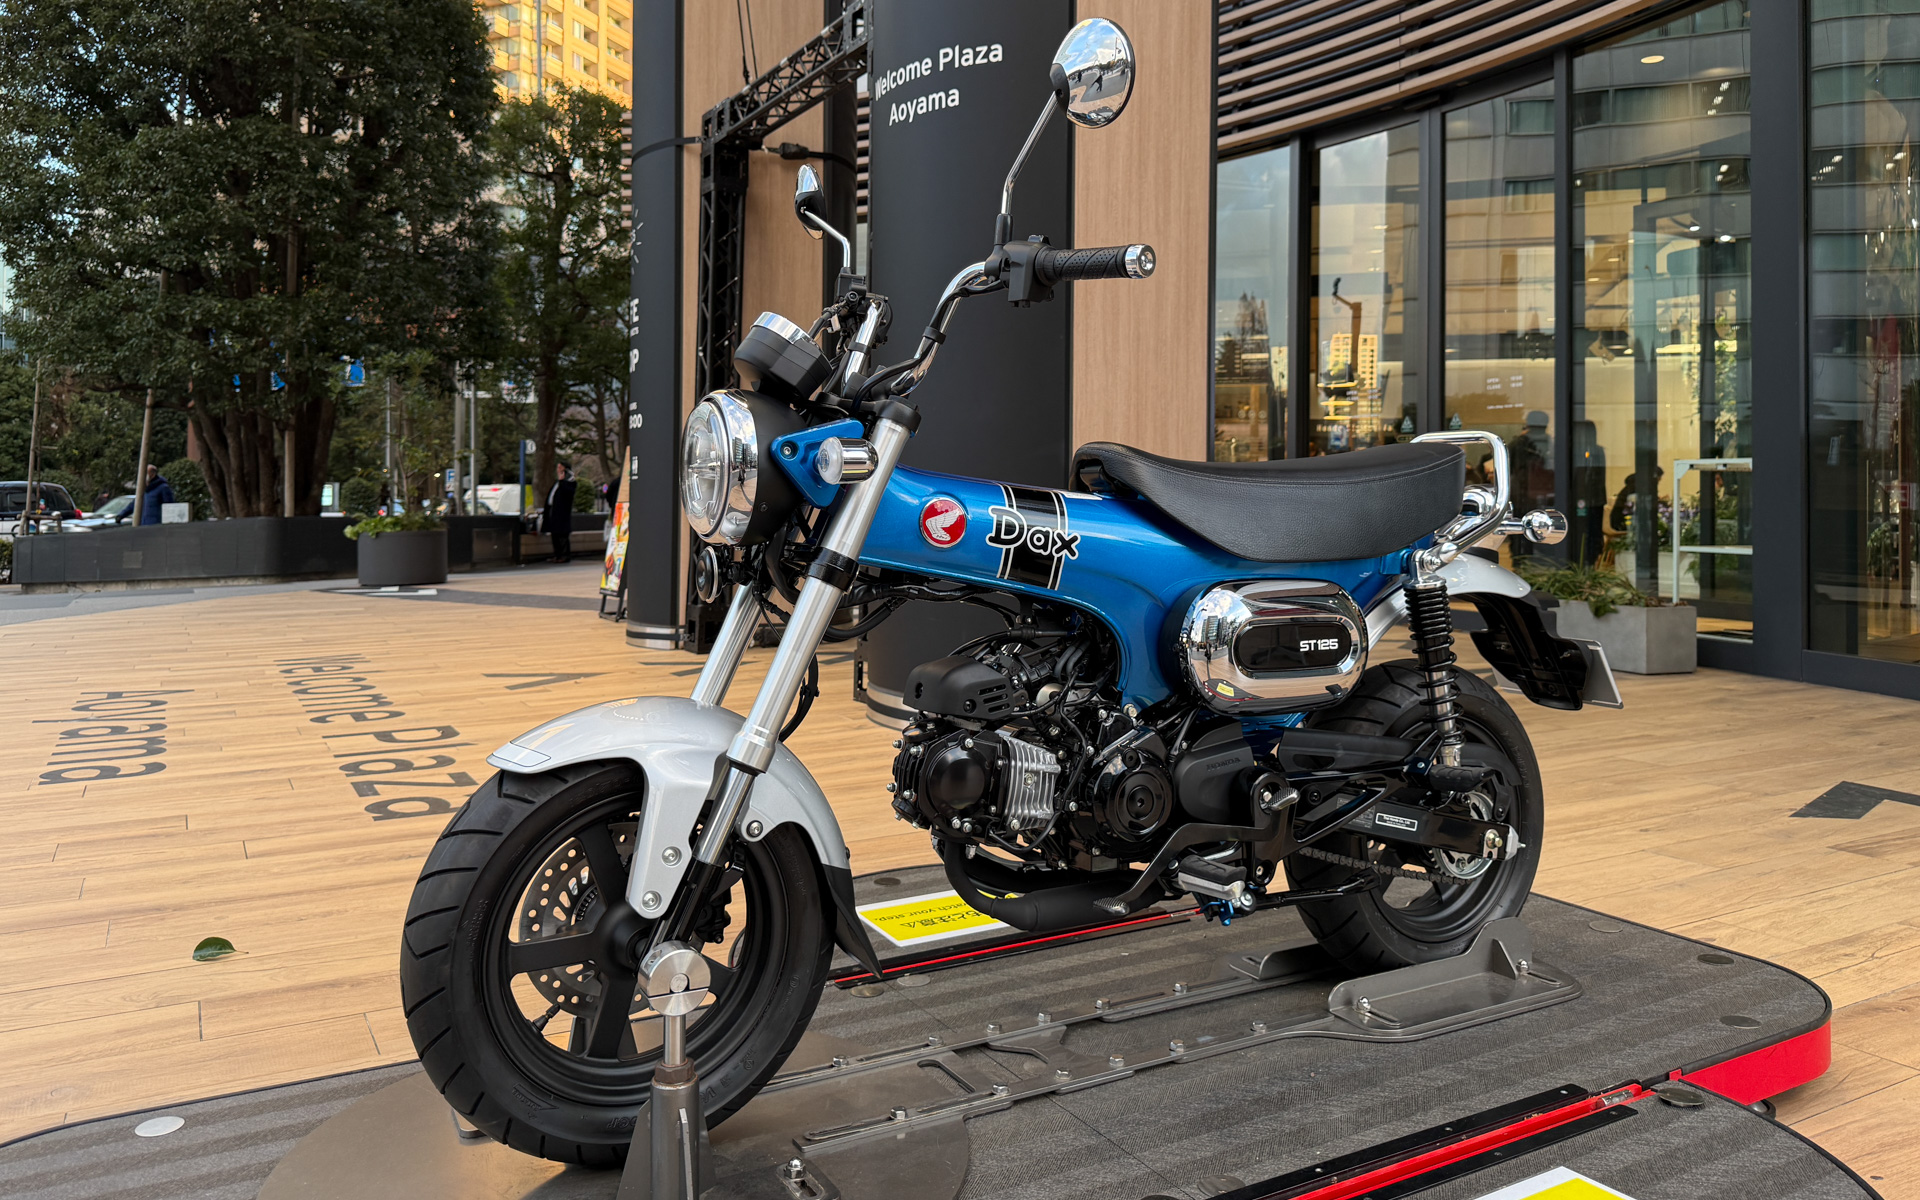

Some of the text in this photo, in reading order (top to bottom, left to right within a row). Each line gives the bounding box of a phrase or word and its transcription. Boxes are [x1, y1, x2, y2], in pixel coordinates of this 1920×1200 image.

[875, 43, 1003, 101] Welcome Plaza
[889, 88, 960, 126] Aoyama
[986, 505, 1081, 560] Dax
[1300, 639, 1339, 652] ST125
[32, 689, 195, 785] Aoyama
[273, 653, 480, 821] Welcome Plaza
[909, 908, 936, 916] your
